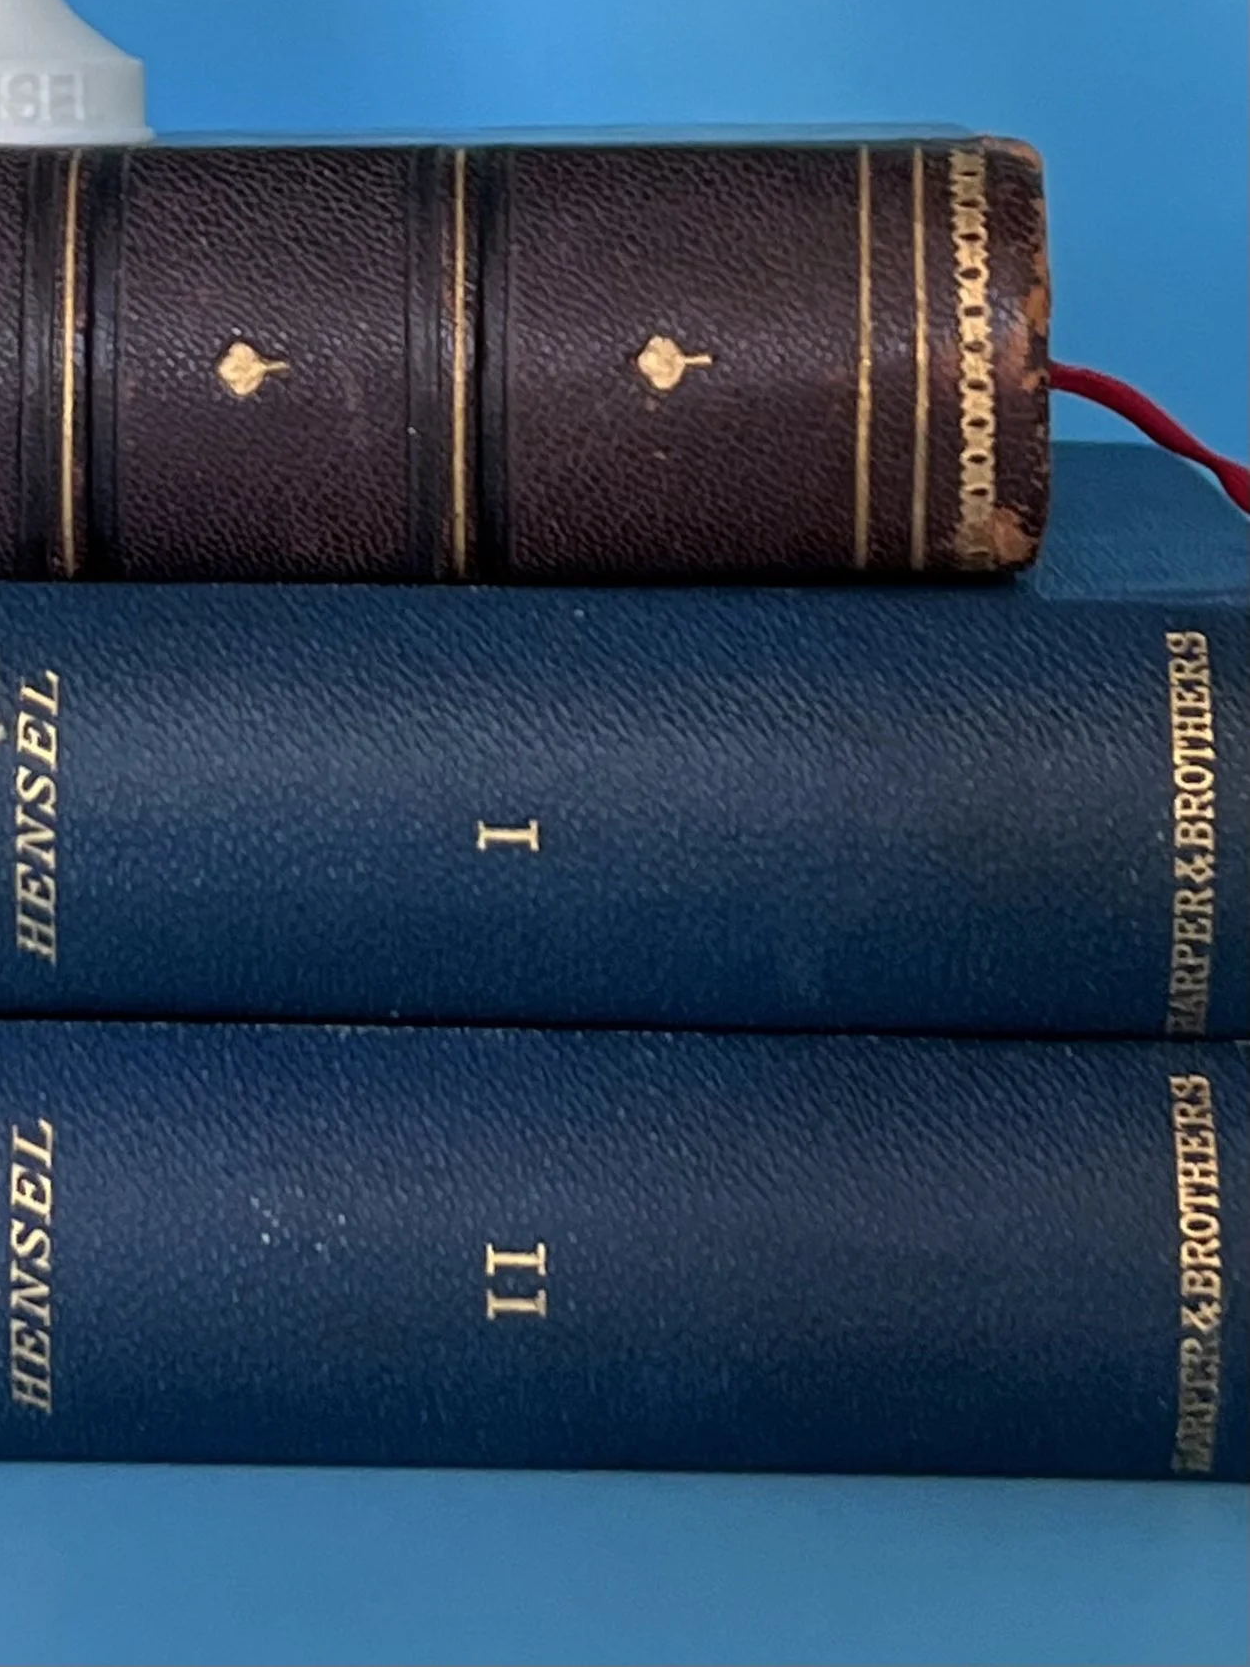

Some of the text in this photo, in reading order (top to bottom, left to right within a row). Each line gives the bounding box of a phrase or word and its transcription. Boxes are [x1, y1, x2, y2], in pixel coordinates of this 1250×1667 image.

[15, 669, 60, 966] HENSEL
[476, 820, 540, 851] I
[1166, 630, 1216, 852] BROTHERS
[1174, 852, 1216, 888] &
[11, 1118, 54, 1414] HENSEL
[486, 1243, 547, 1320] II
[1169, 1073, 1223, 1299] BROTHERS
